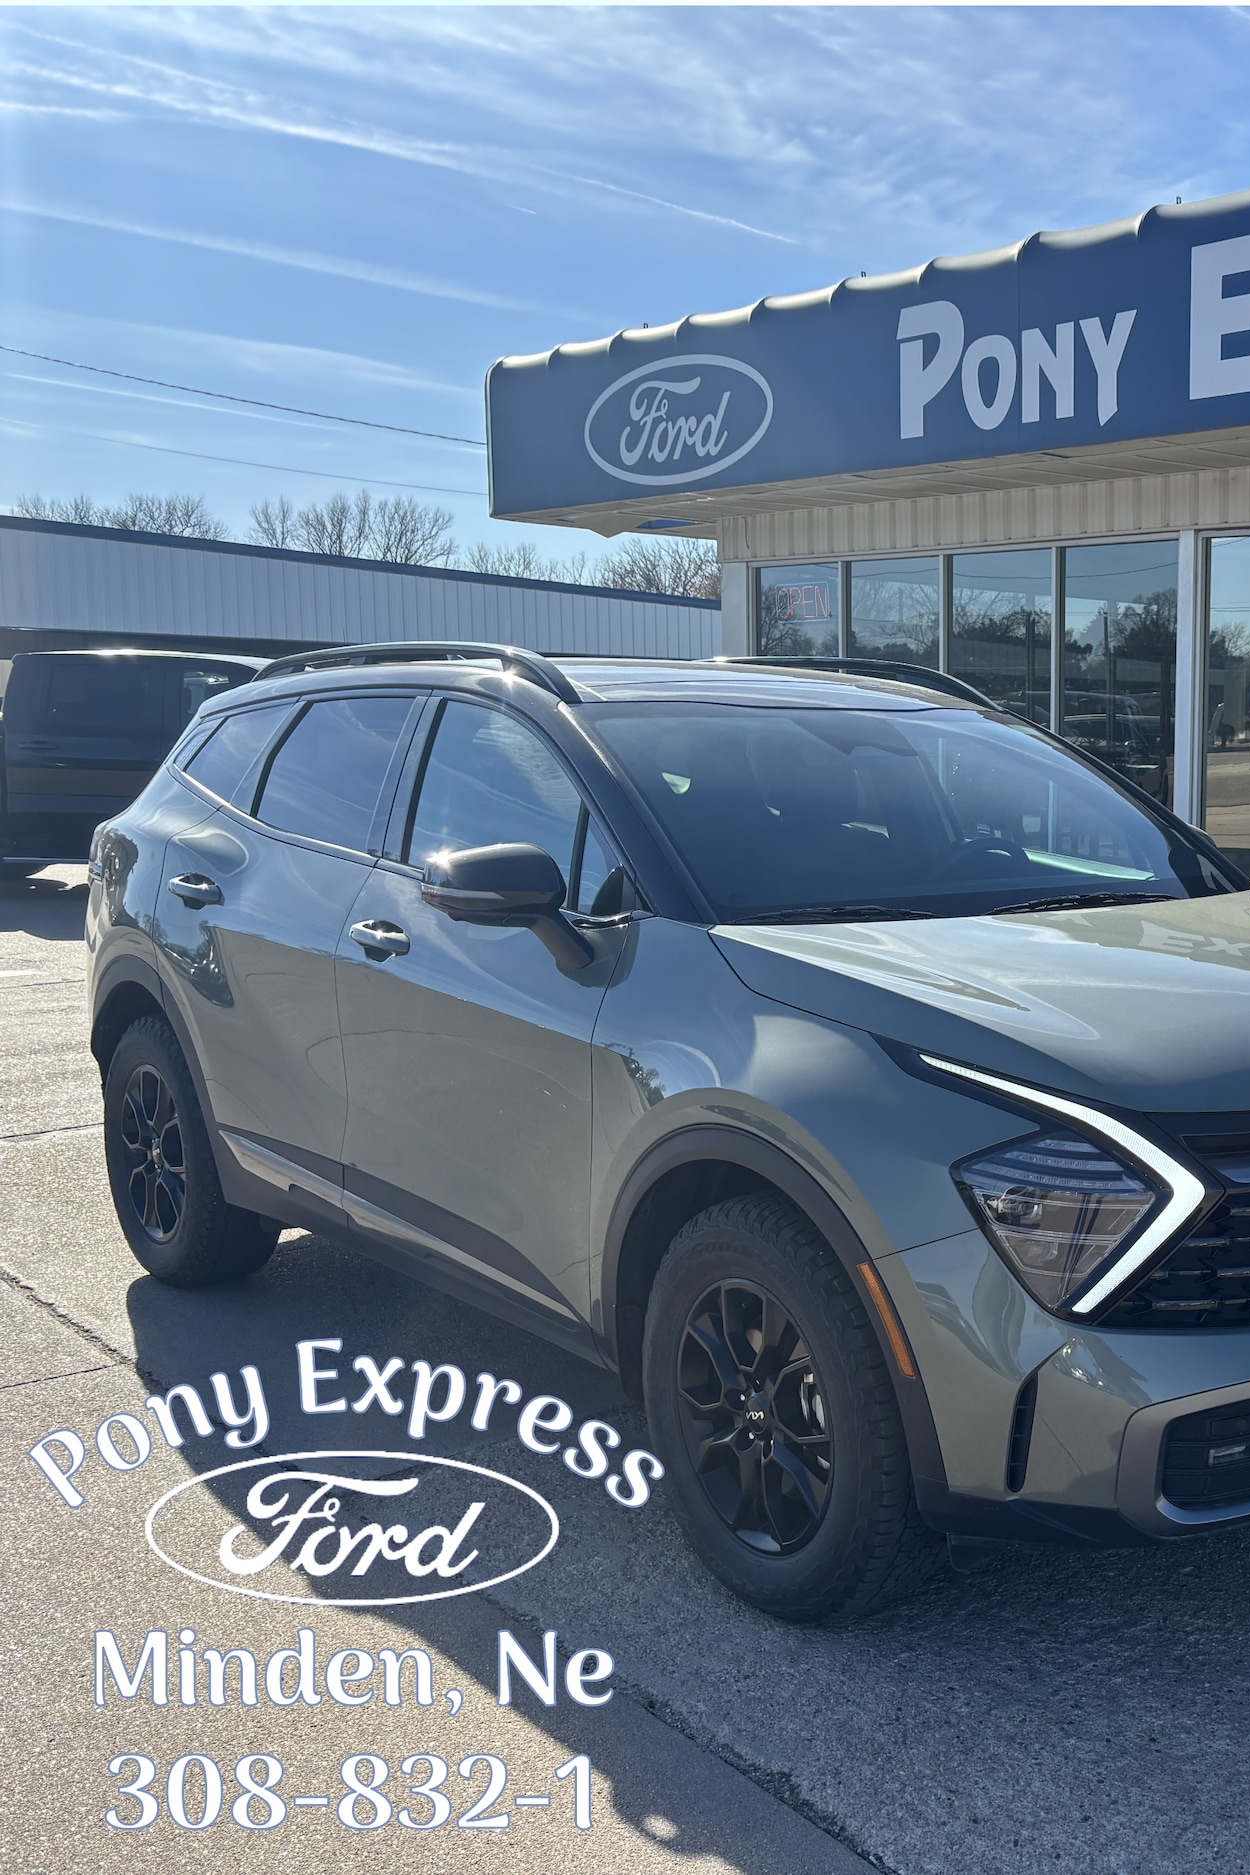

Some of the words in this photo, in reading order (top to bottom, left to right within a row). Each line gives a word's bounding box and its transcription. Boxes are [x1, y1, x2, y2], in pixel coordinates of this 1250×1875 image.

[895, 300, 1138, 440] PONY
[619, 375, 731, 467] Ford
[777, 585, 829, 620] OPEN
